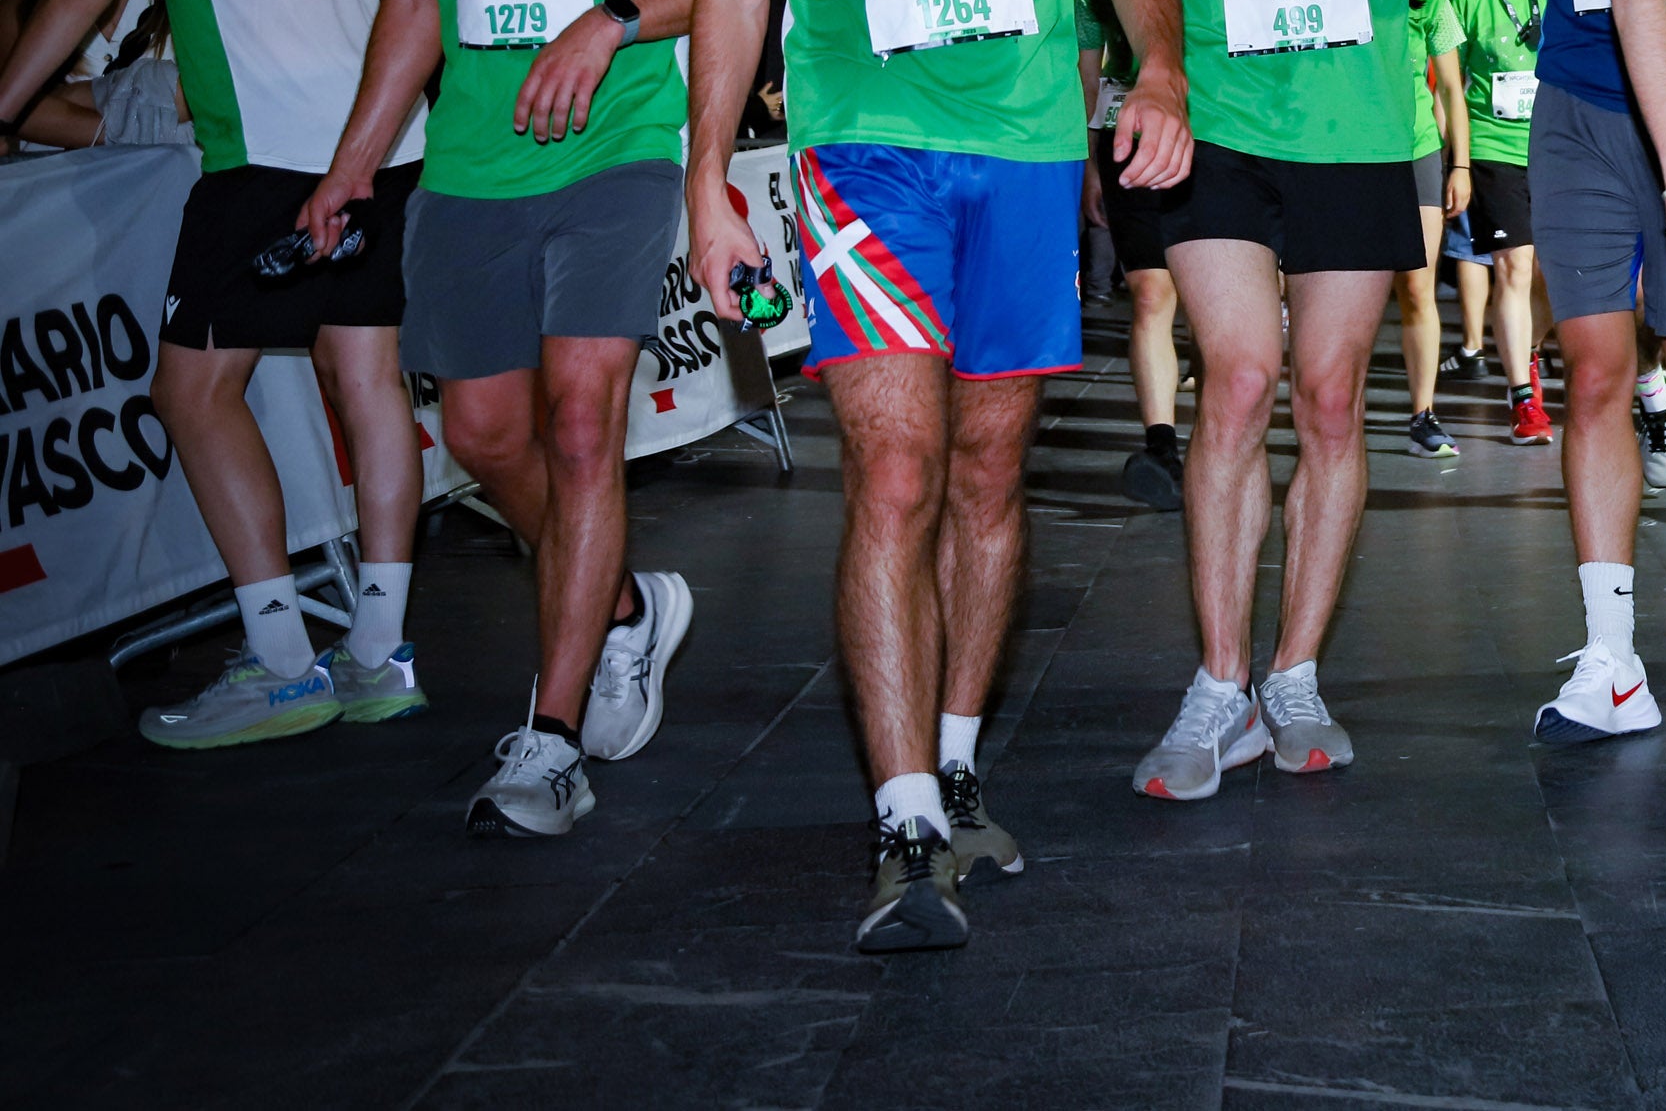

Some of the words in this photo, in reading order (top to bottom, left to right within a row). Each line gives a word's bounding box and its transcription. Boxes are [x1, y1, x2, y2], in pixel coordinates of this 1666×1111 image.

[484, 2, 548, 35] 1279
[1272, 3, 1325, 37] 499
[0, 292, 151, 416] ARIO
[268, 676, 326, 708] HOKA
